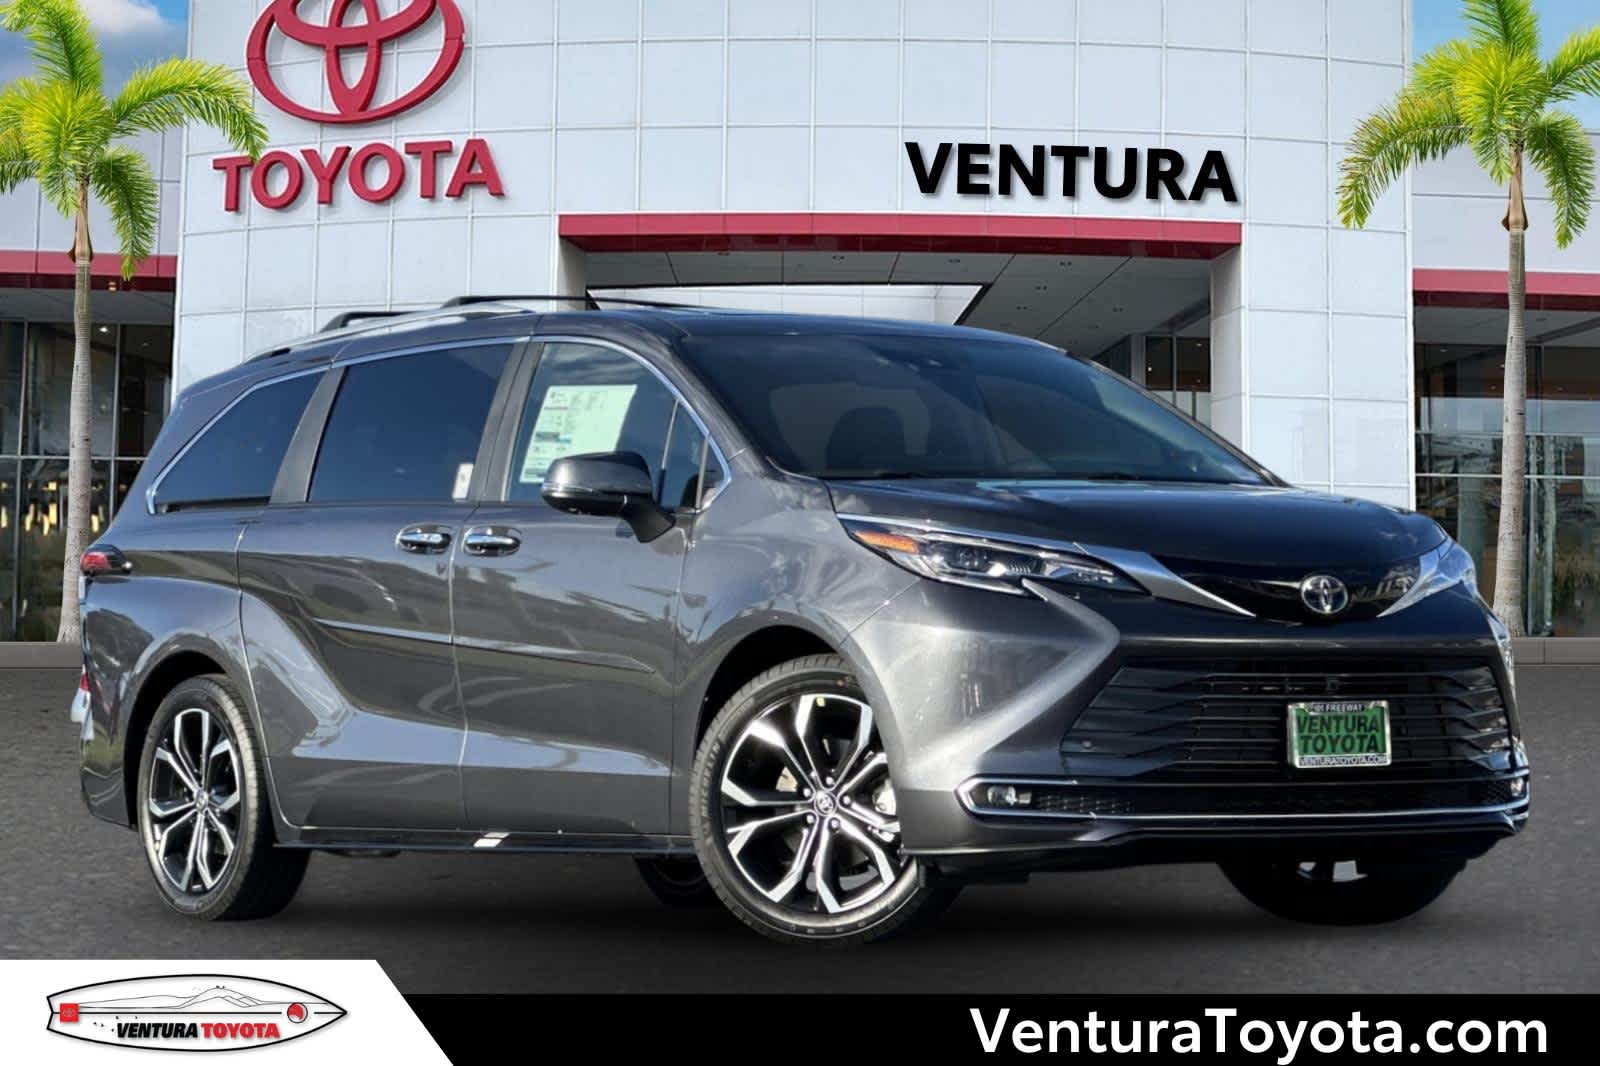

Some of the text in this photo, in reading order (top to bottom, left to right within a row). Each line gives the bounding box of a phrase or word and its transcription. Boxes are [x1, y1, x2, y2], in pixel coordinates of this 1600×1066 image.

[213, 138, 504, 212] TOYOTA
[905, 142, 1238, 203] VENTURA
[1297, 715, 1380, 733] VENTURA
[1300, 734, 1379, 753] TOYOTA
